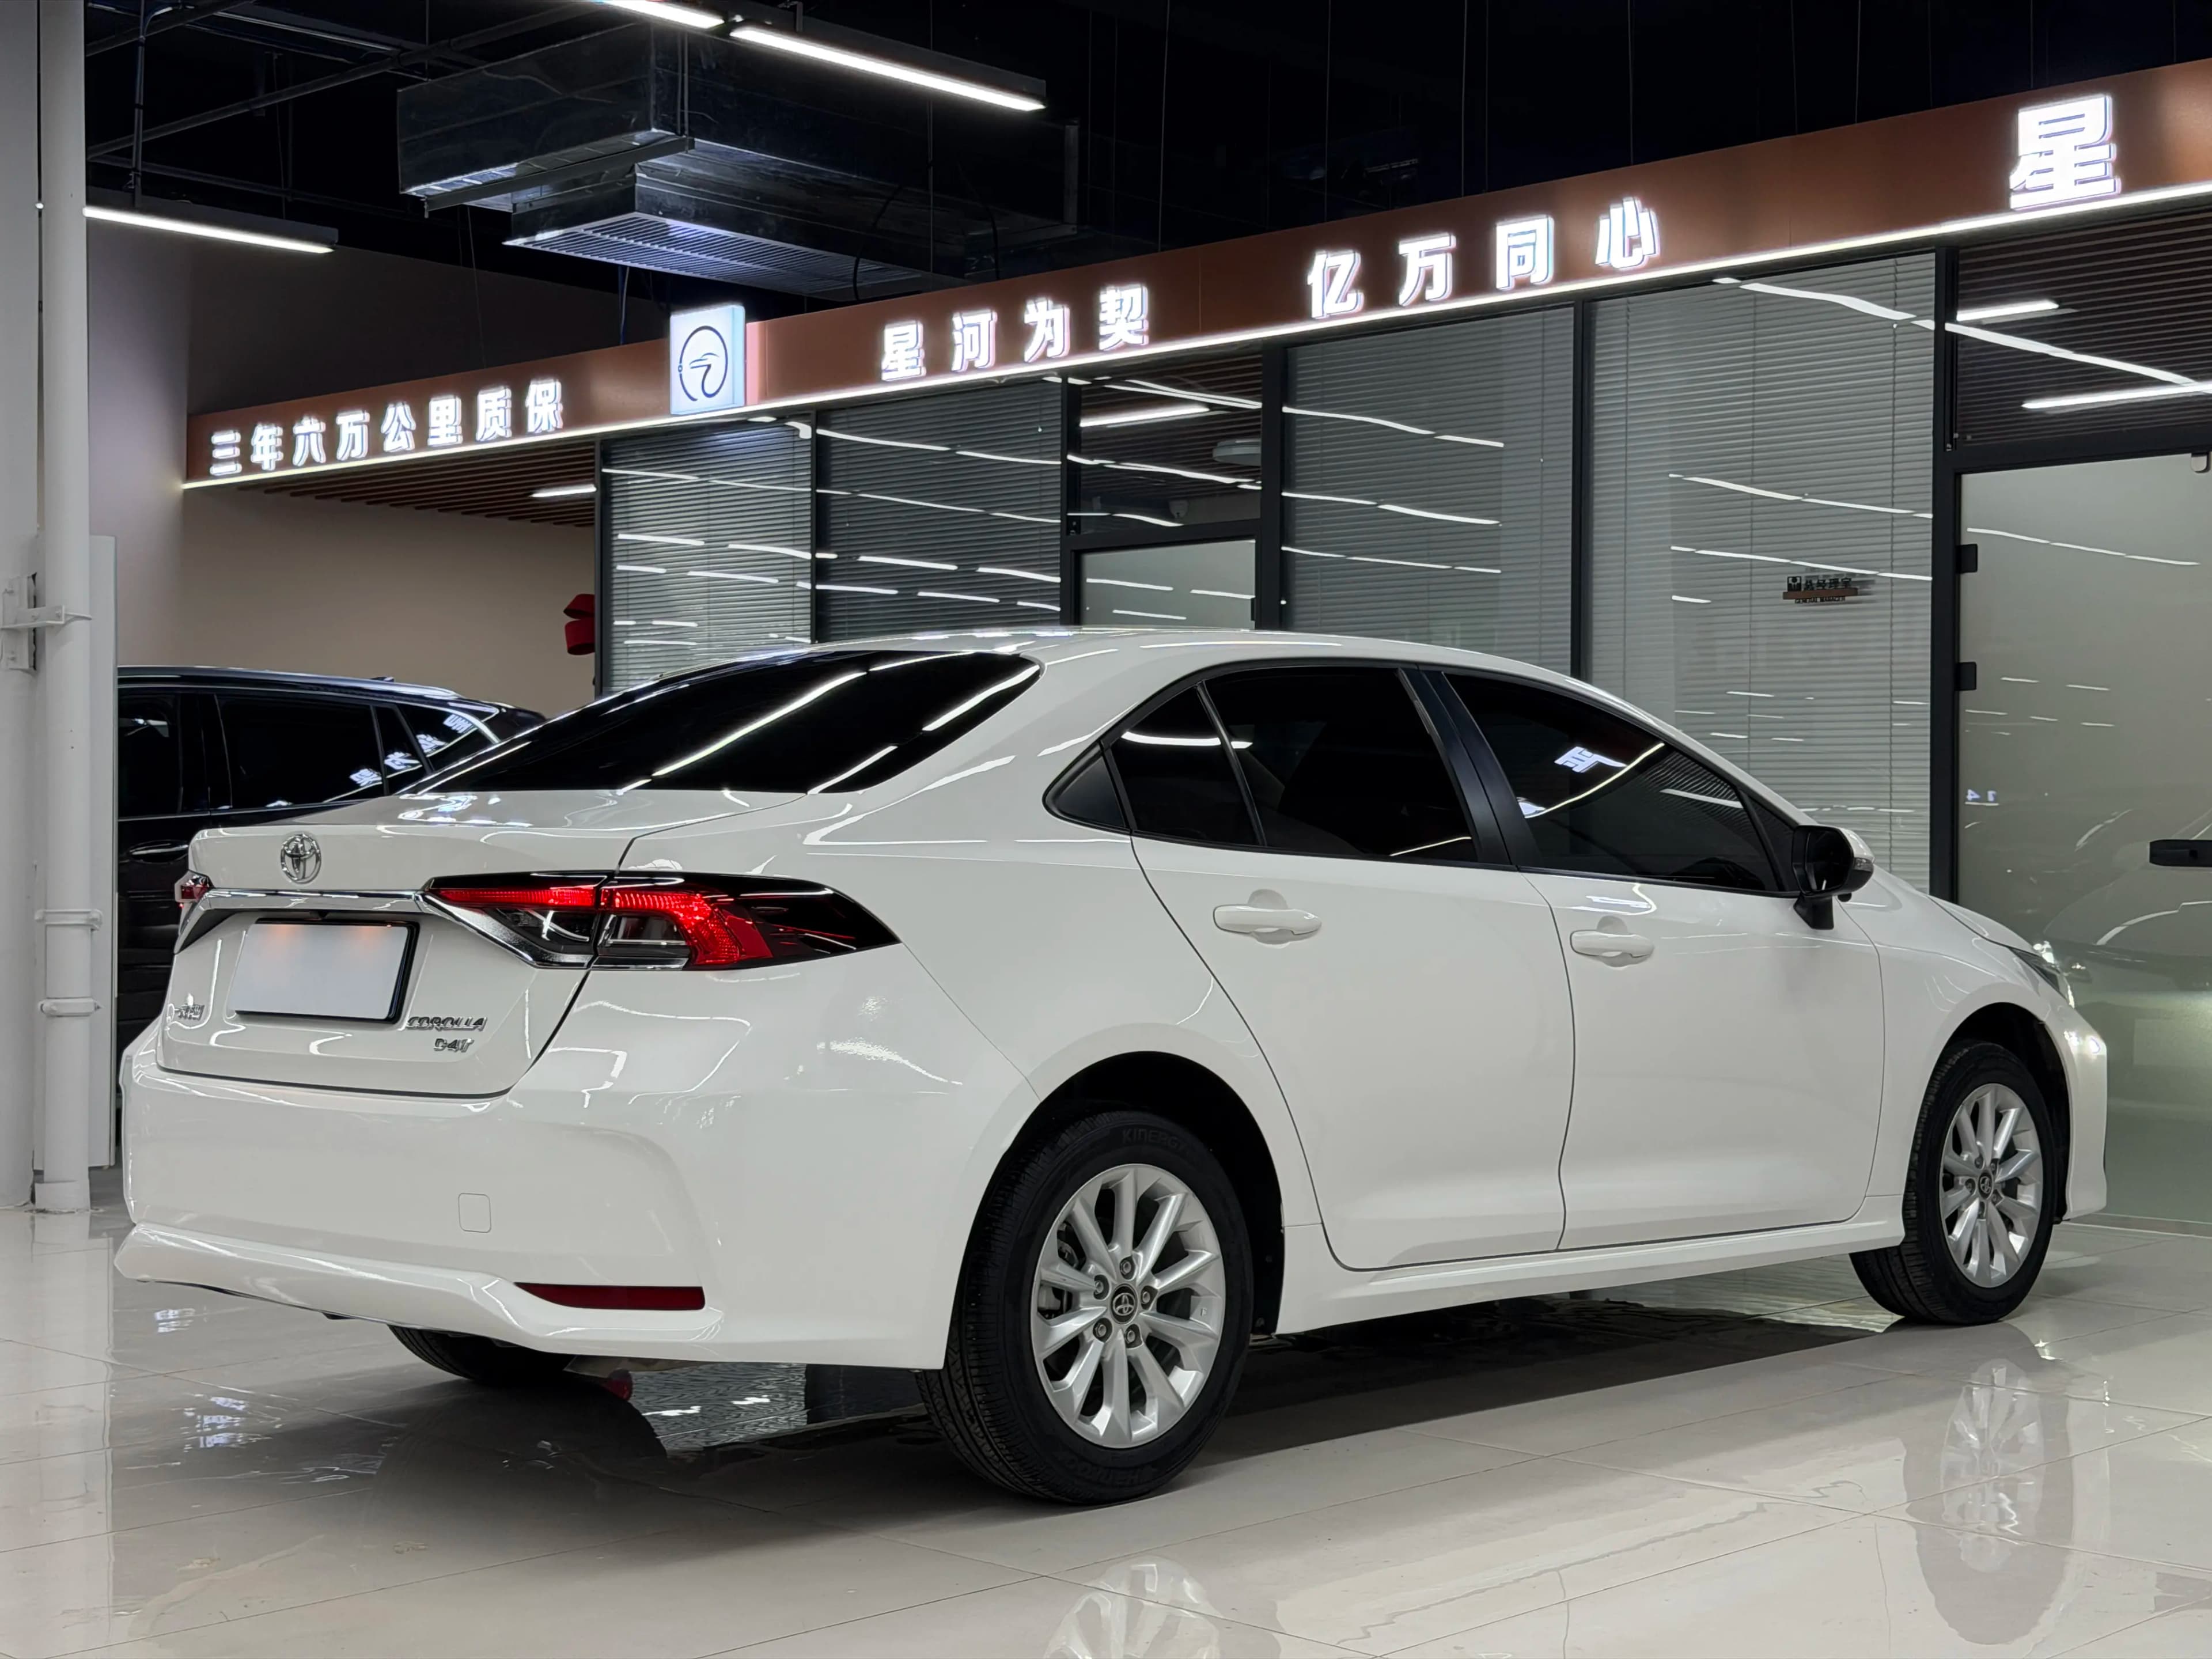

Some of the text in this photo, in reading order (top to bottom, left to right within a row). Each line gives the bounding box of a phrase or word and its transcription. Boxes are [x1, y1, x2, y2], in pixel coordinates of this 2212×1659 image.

[2009, 94, 2122, 211] 星
[881, 197, 1660, 381] 星河为契 亿万同心
[210, 377, 563, 476] 三年六万公里质保
[405, 1017, 487, 1031] COROLLA
